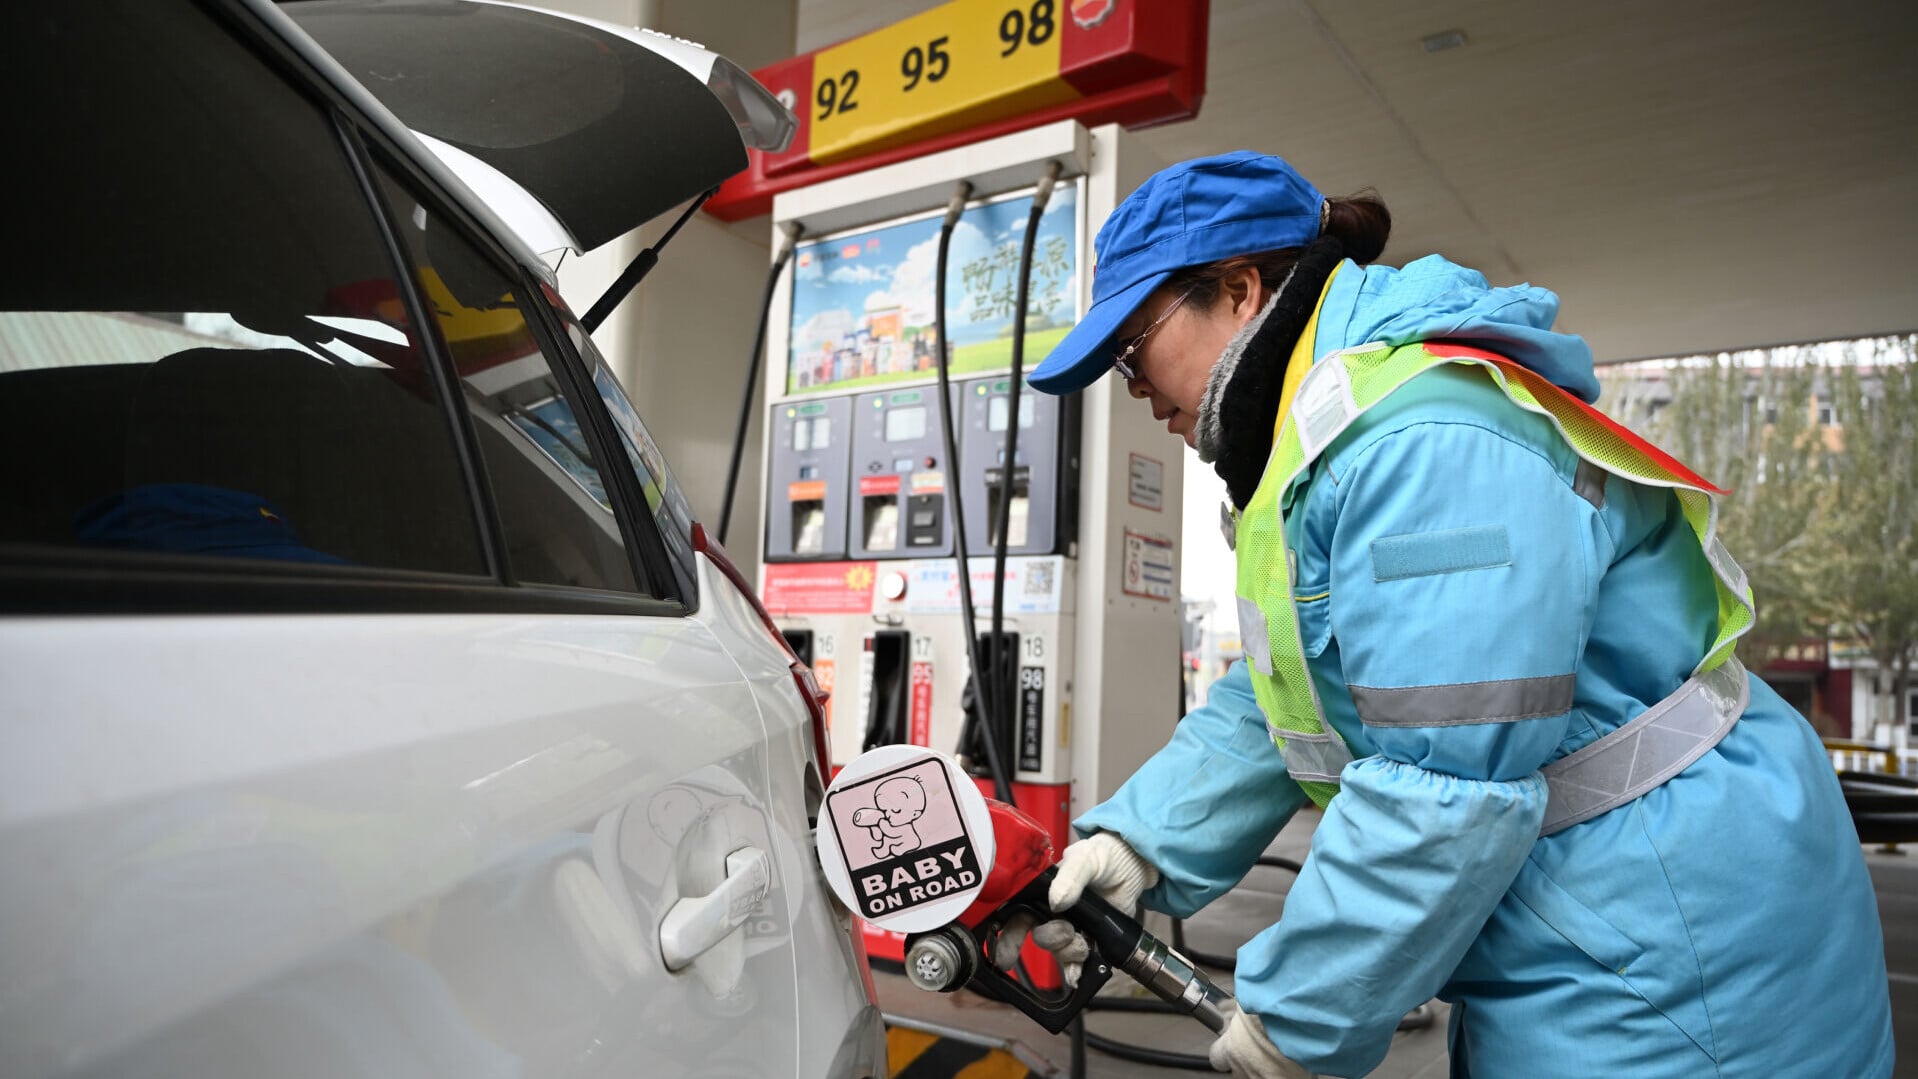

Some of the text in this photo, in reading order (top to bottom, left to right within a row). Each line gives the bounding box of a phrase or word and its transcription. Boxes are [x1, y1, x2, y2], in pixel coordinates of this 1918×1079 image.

[816, 0, 1055, 121] 92 95 98
[914, 635, 932, 656] 17
[1025, 635, 1044, 658] 18
[912, 662, 933, 685] 95
[1021, 667, 1043, 690] 98
[861, 846, 967, 897] BABY
[869, 870, 976, 914] ON ROAD
